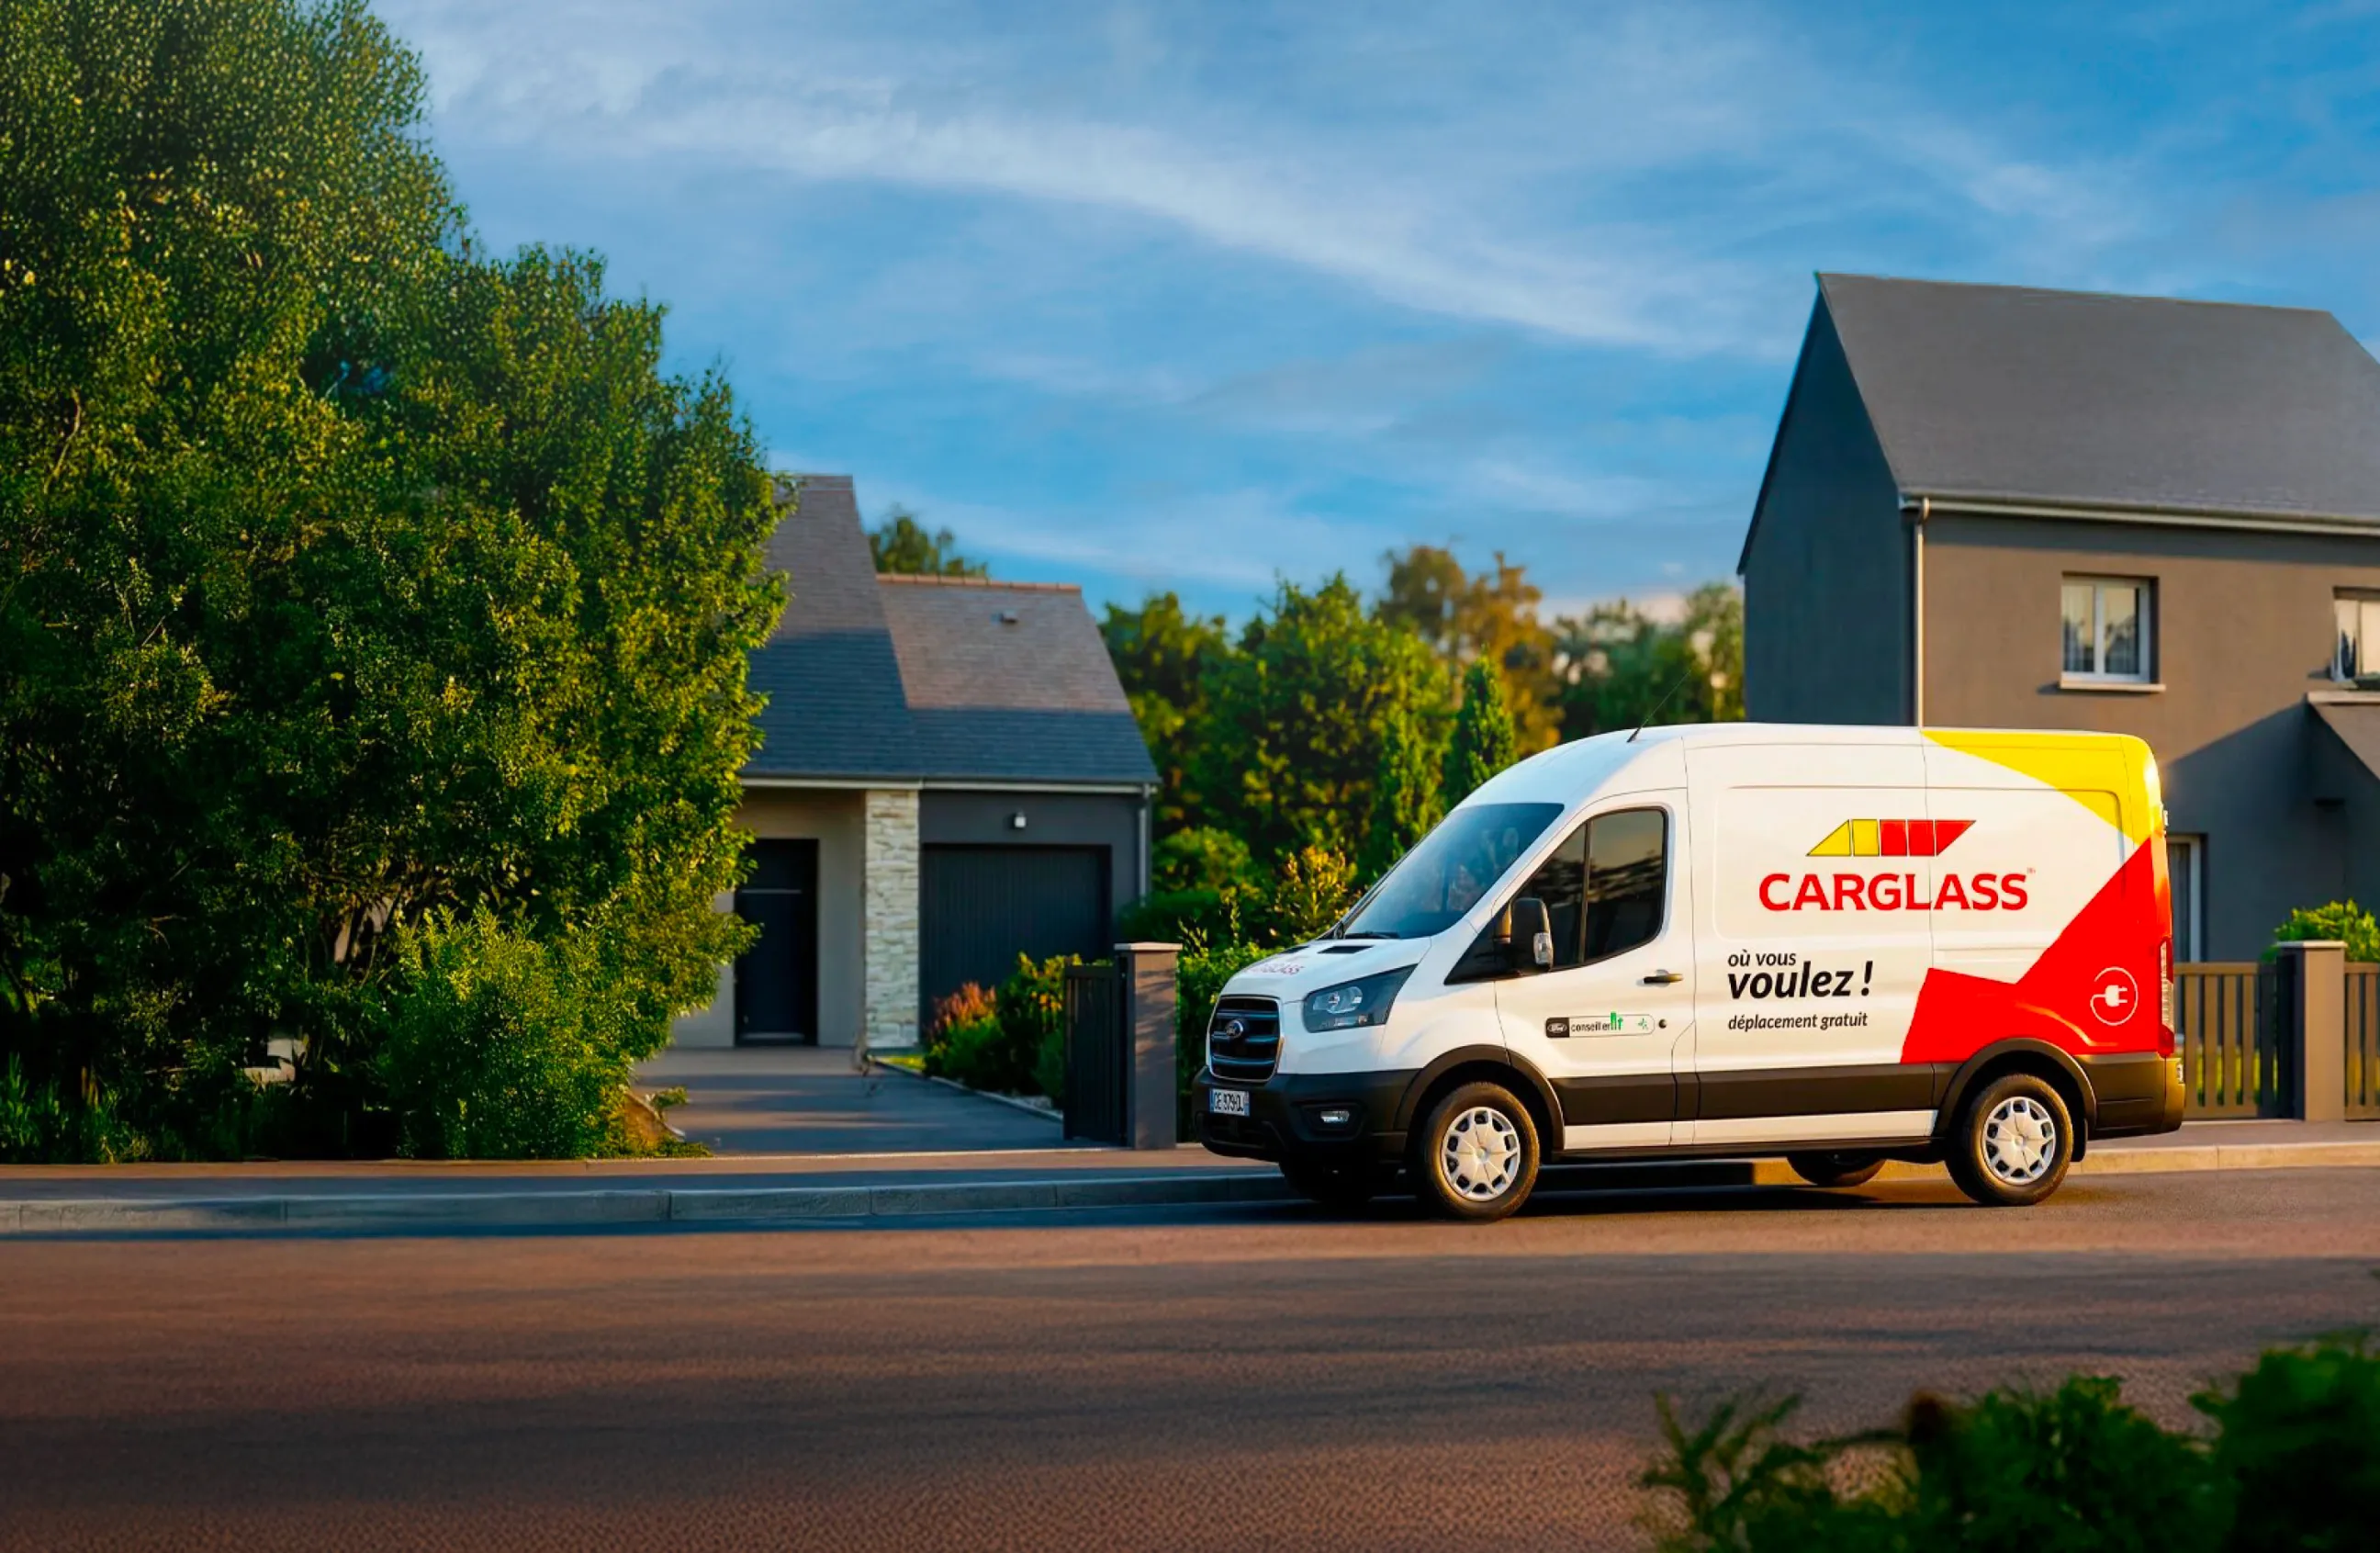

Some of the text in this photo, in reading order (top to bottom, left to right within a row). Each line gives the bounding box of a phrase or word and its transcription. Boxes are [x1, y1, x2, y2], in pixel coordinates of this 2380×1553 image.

[1758, 872, 2028, 912] CARGLASS
[1727, 950, 1797, 967] où vous
[1727, 961, 1855, 999] voulez
[1728, 1012, 1868, 1032] déplacement gratuit
